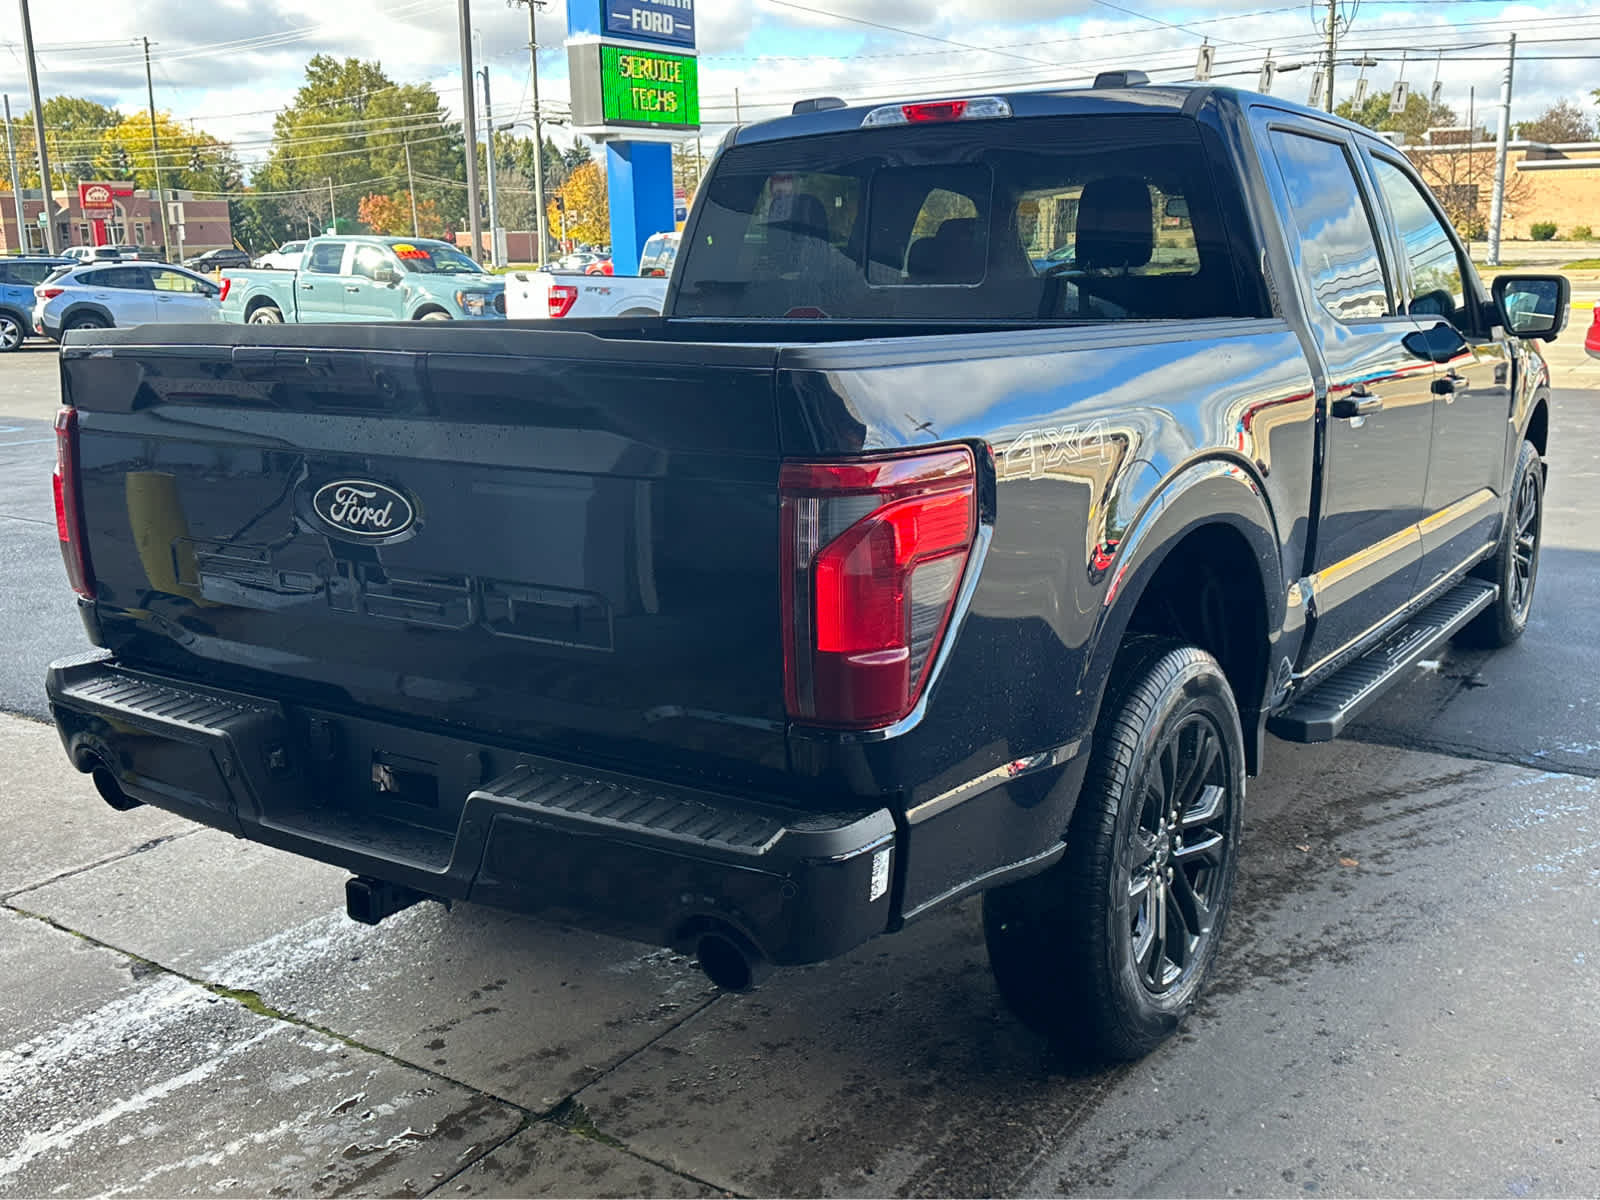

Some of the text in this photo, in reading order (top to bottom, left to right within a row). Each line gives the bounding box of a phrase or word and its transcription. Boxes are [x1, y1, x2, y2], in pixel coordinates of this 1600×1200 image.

[632, 8, 673, 34] FORD
[619, 55, 683, 83] SERVICE
[630, 87, 678, 113] TECHS
[330, 486, 393, 528] Ford
